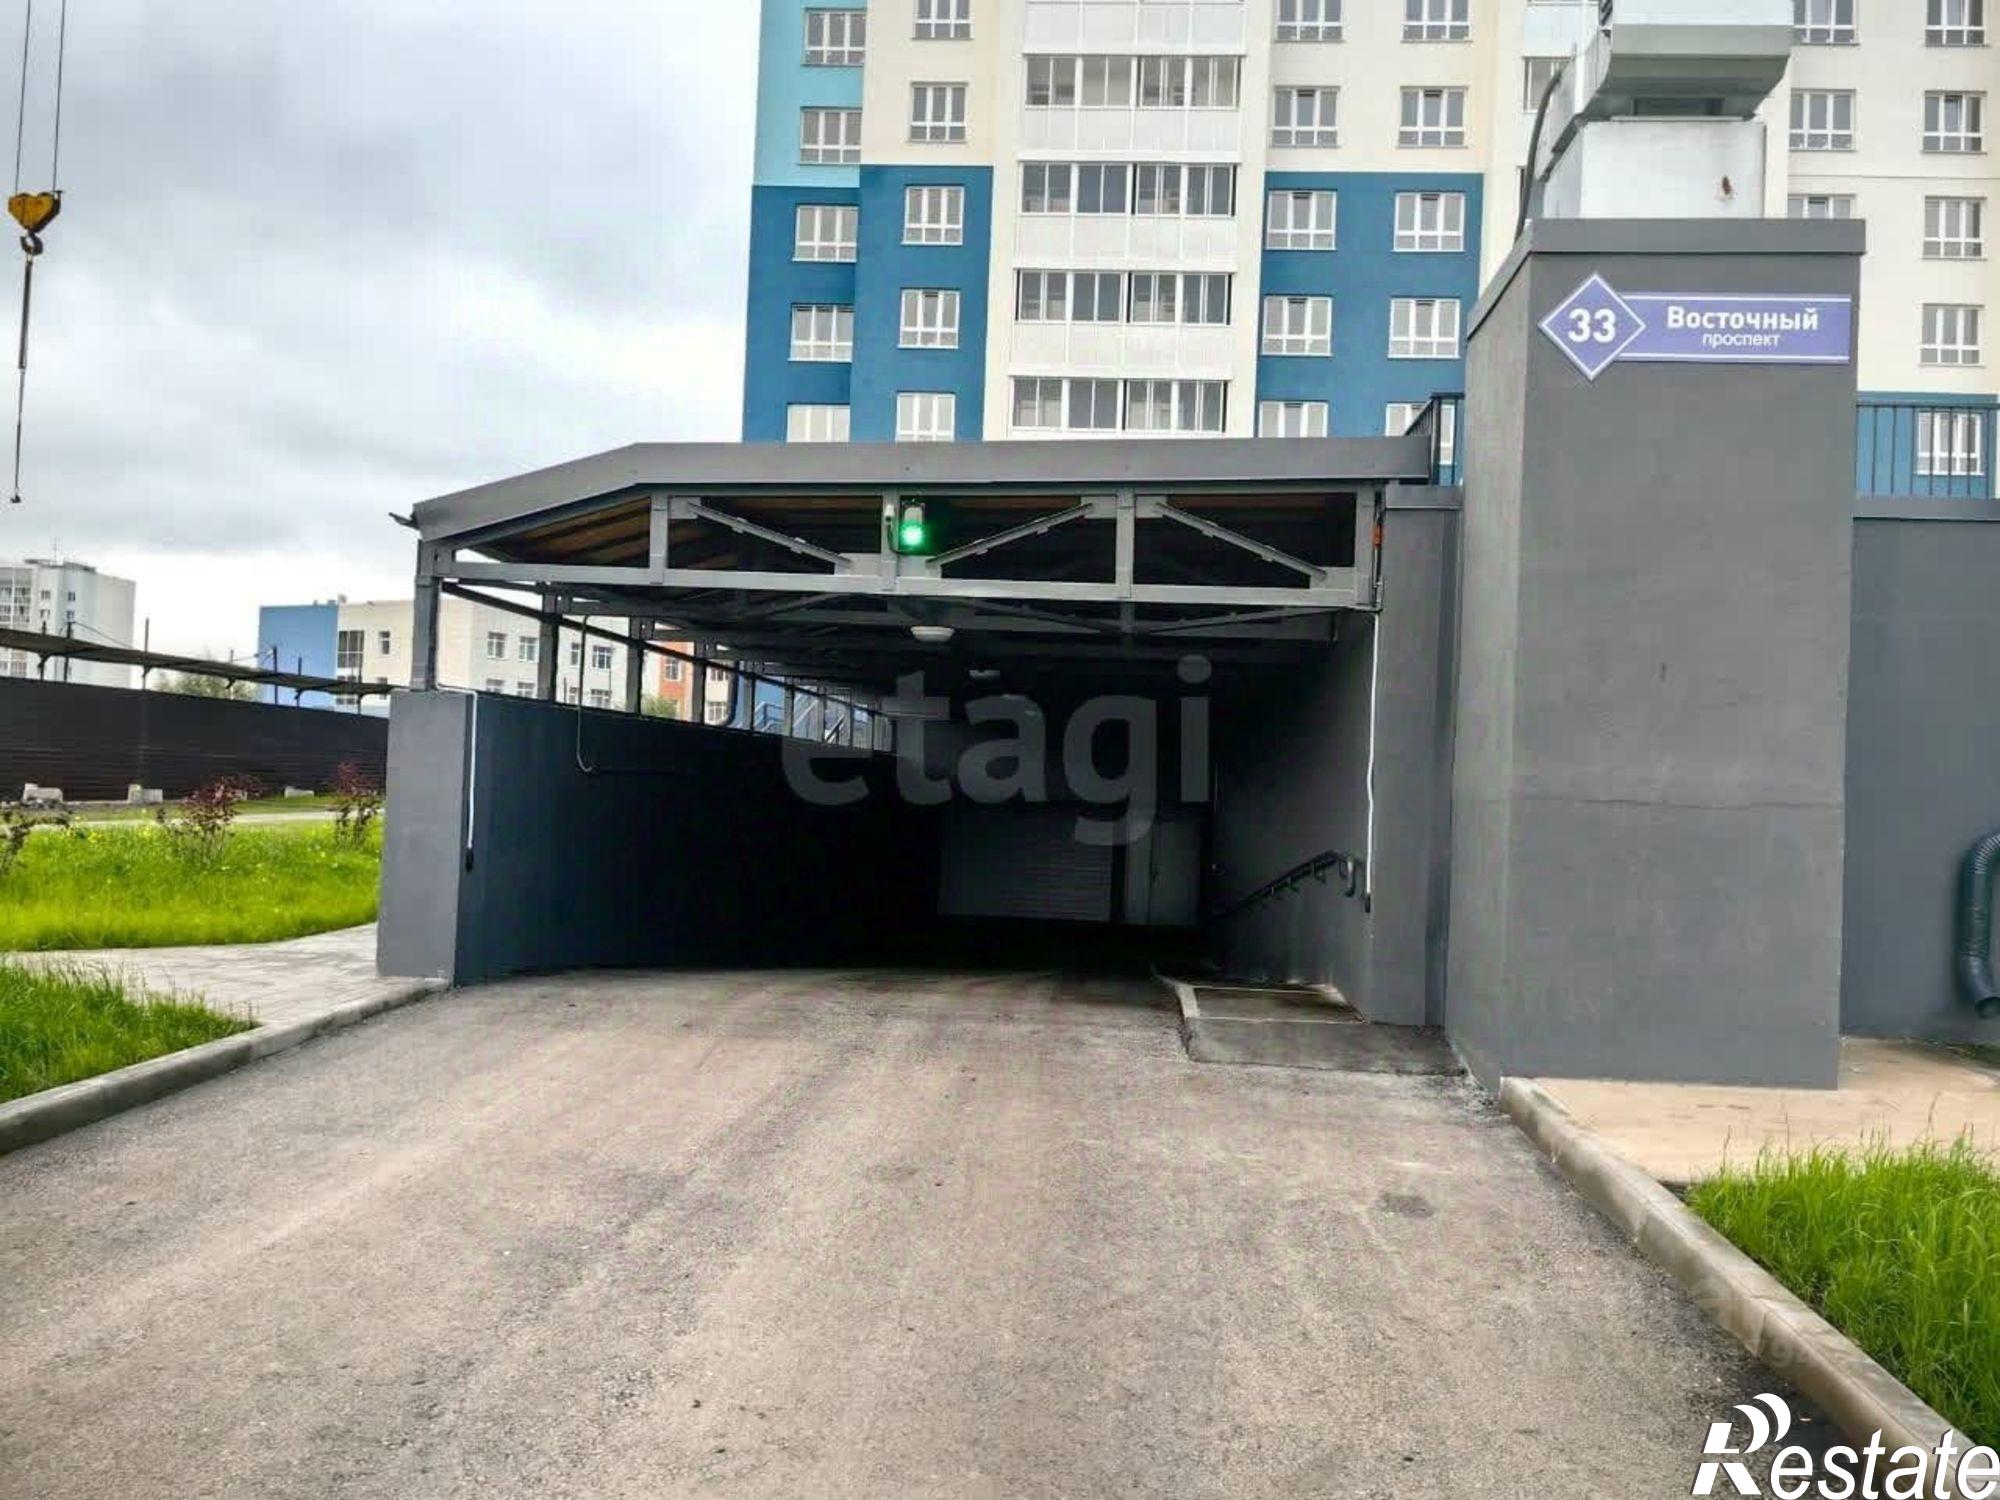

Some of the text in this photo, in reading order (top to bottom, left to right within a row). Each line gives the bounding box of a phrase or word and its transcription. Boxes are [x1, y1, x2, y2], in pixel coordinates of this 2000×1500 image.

[1567, 307, 1617, 343] 33
[1666, 305, 1819, 331] Восточный
[1702, 331, 1782, 349] проспект
